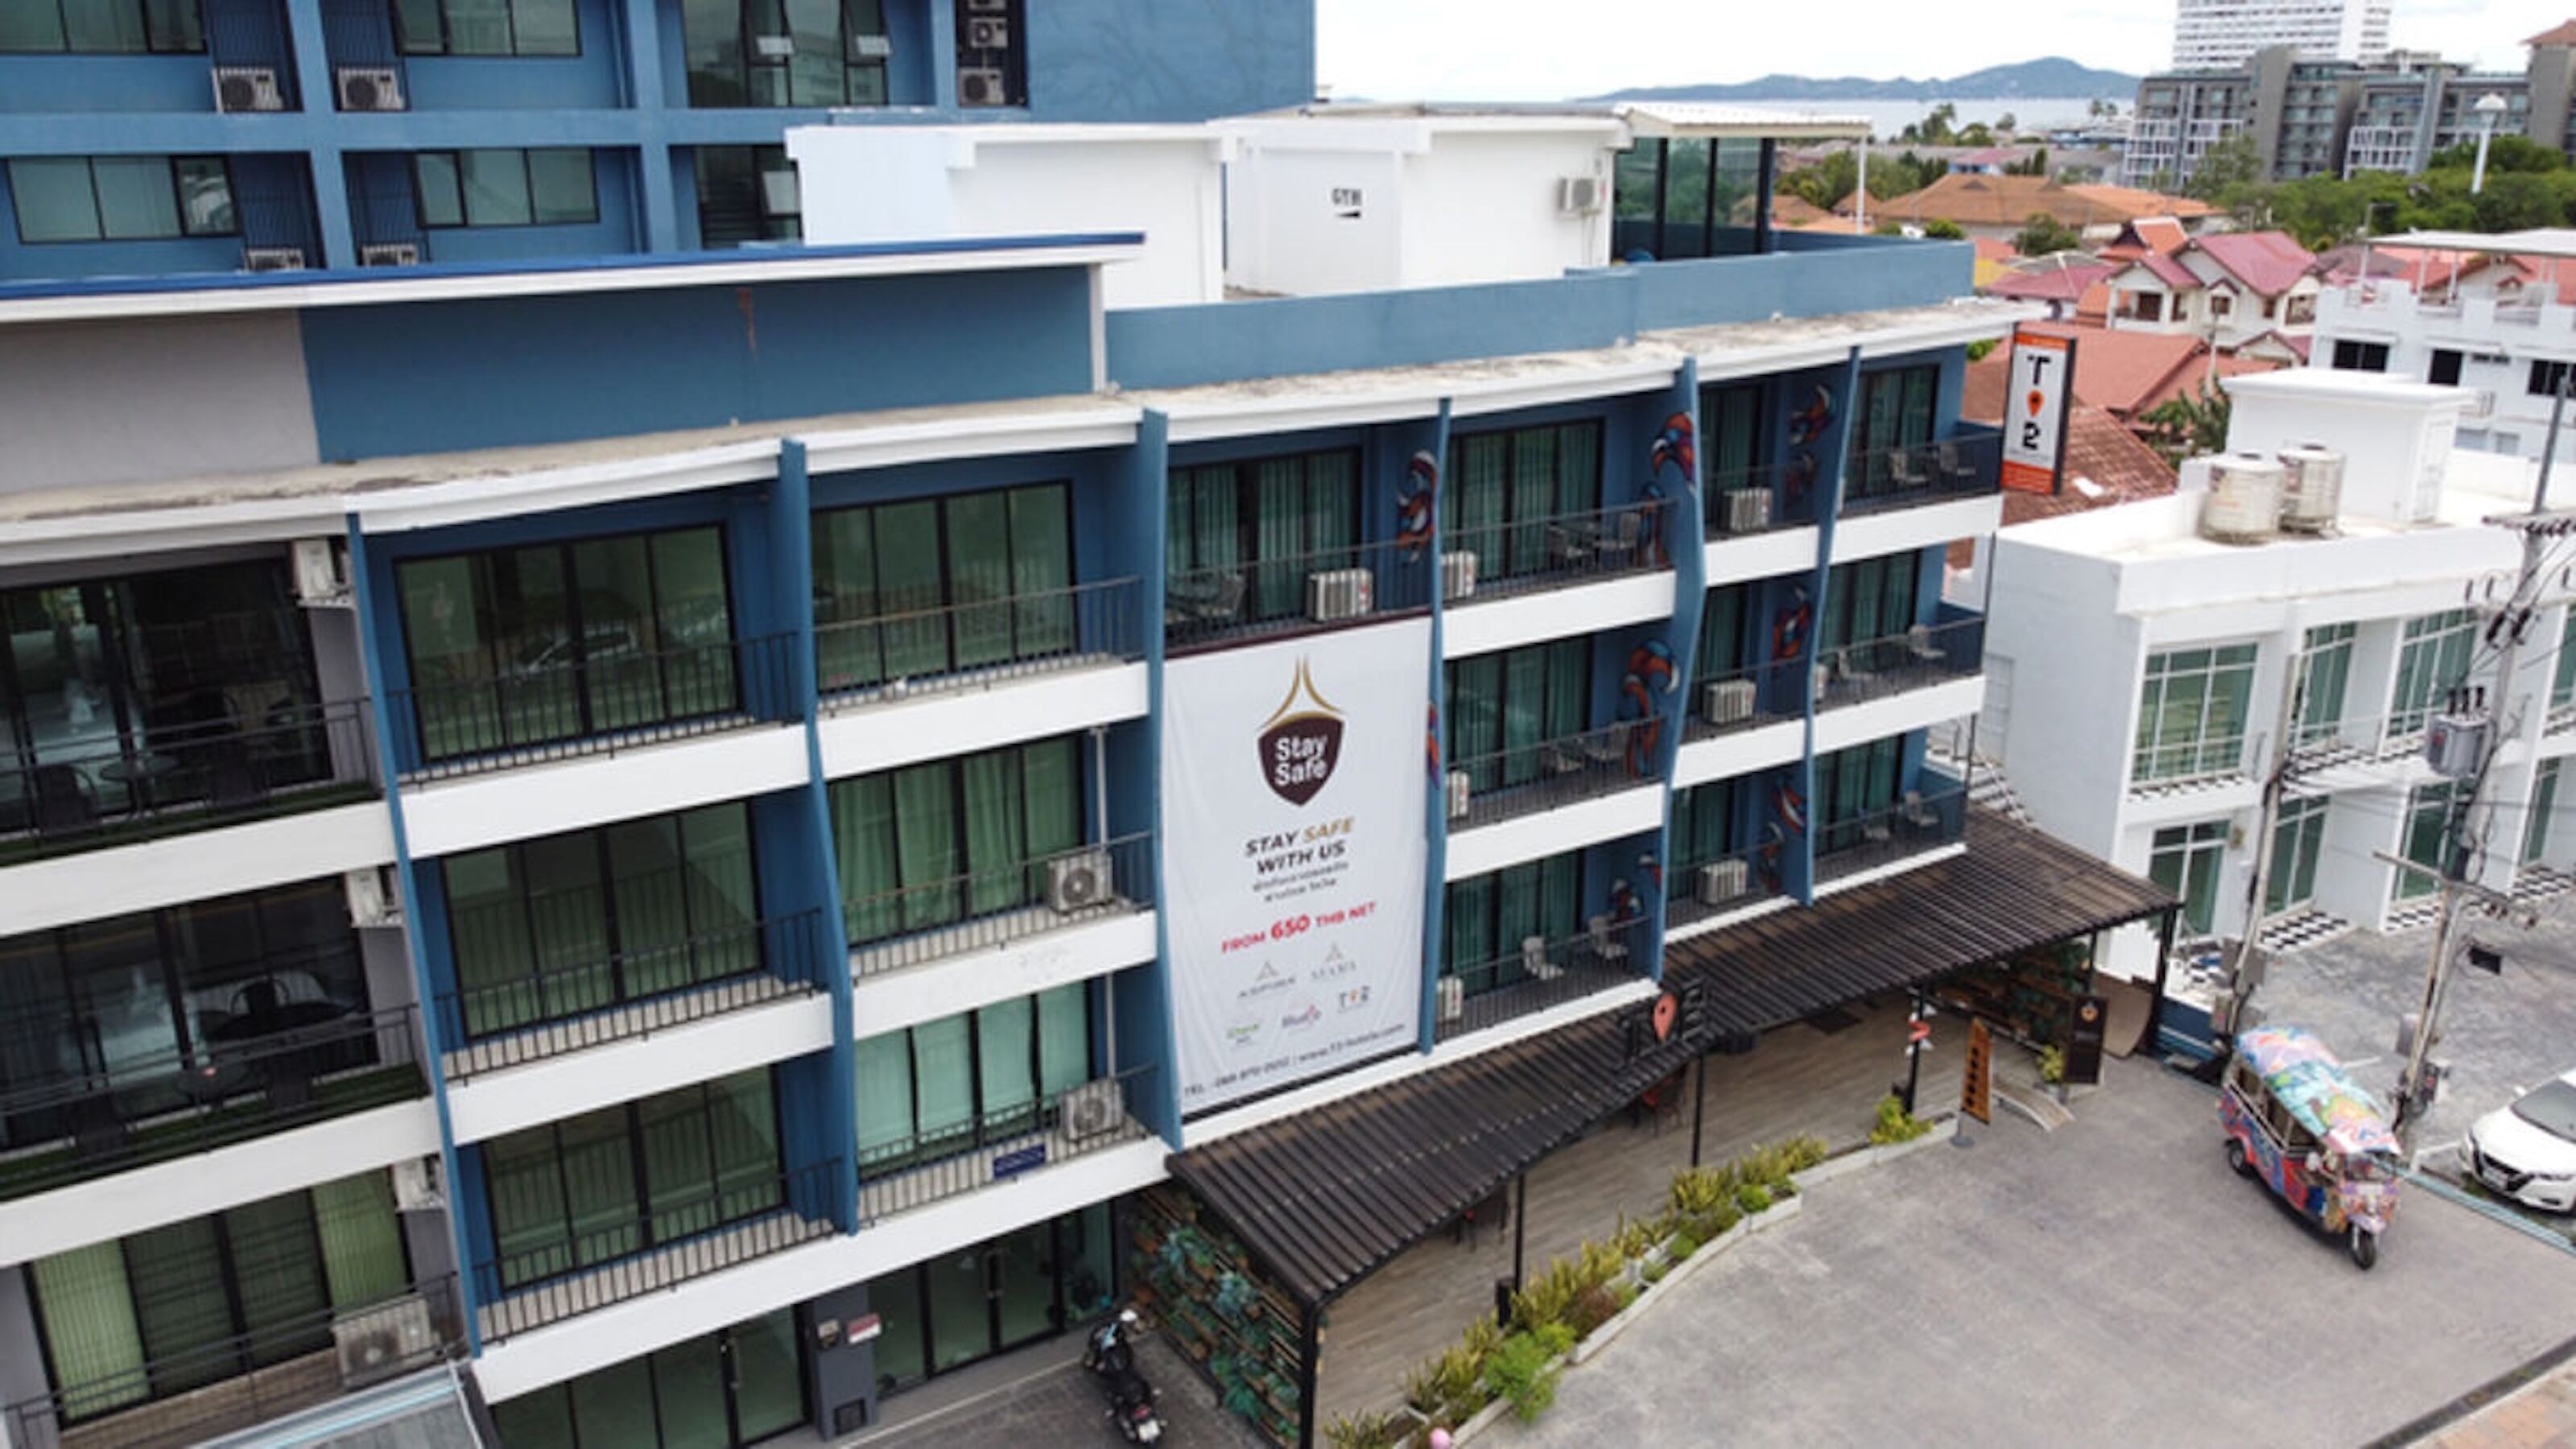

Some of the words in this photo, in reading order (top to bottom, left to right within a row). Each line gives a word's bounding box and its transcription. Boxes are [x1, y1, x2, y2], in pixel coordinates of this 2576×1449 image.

[1331, 188, 1362, 206] GYM
[1274, 734, 1327, 762] Stay
[1274, 756, 1327, 786] Safe
[1246, 830, 1298, 857] STAY
[1304, 817, 1353, 843] SAFE
[1257, 848, 1314, 875] WITH
[1319, 839, 1346, 861] US
[1221, 930, 1265, 954] FROM
[1270, 914, 1311, 939] 650
[1315, 907, 1345, 927] THB
[1348, 900, 1377, 919] NET
